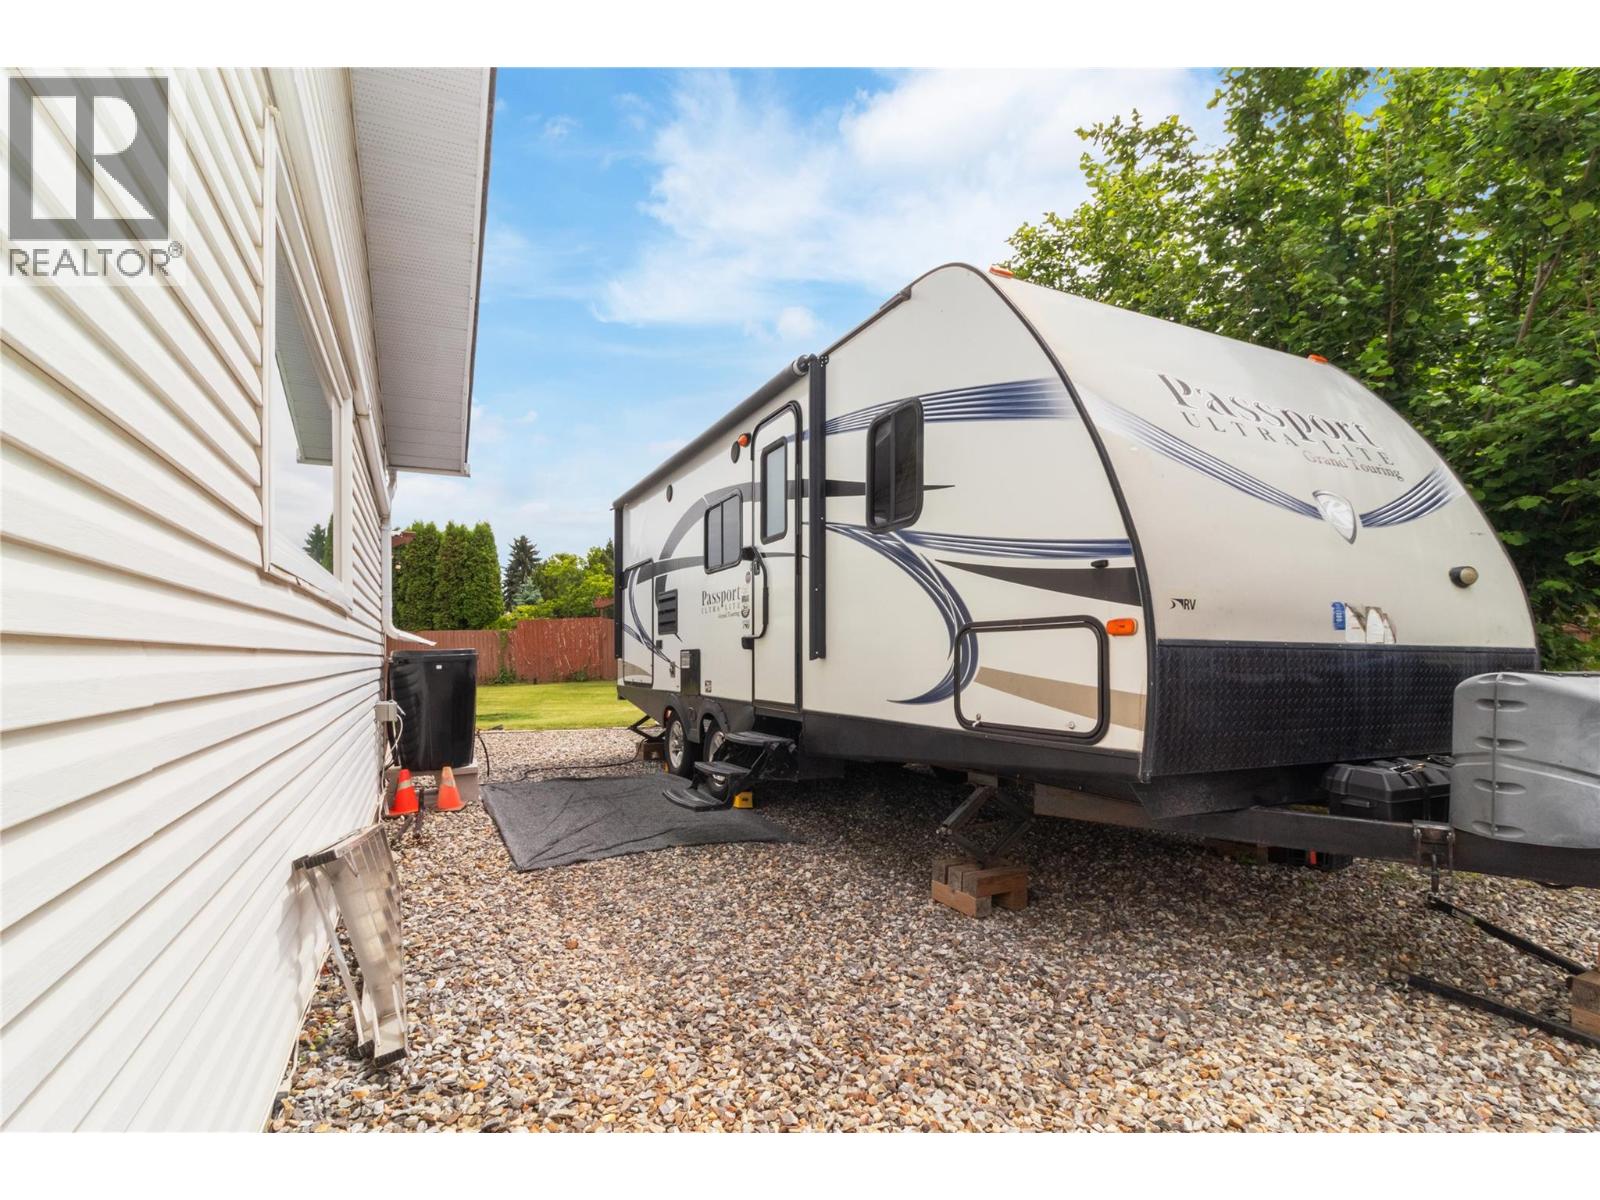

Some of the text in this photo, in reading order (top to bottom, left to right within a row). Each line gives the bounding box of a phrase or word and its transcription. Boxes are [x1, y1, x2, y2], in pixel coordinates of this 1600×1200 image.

[1157, 374, 1381, 448] Passport
[1181, 411, 1395, 466] ULTRA LITE
[1303, 450, 1405, 482] Grand Touring
[701, 586, 741, 607] Passport
